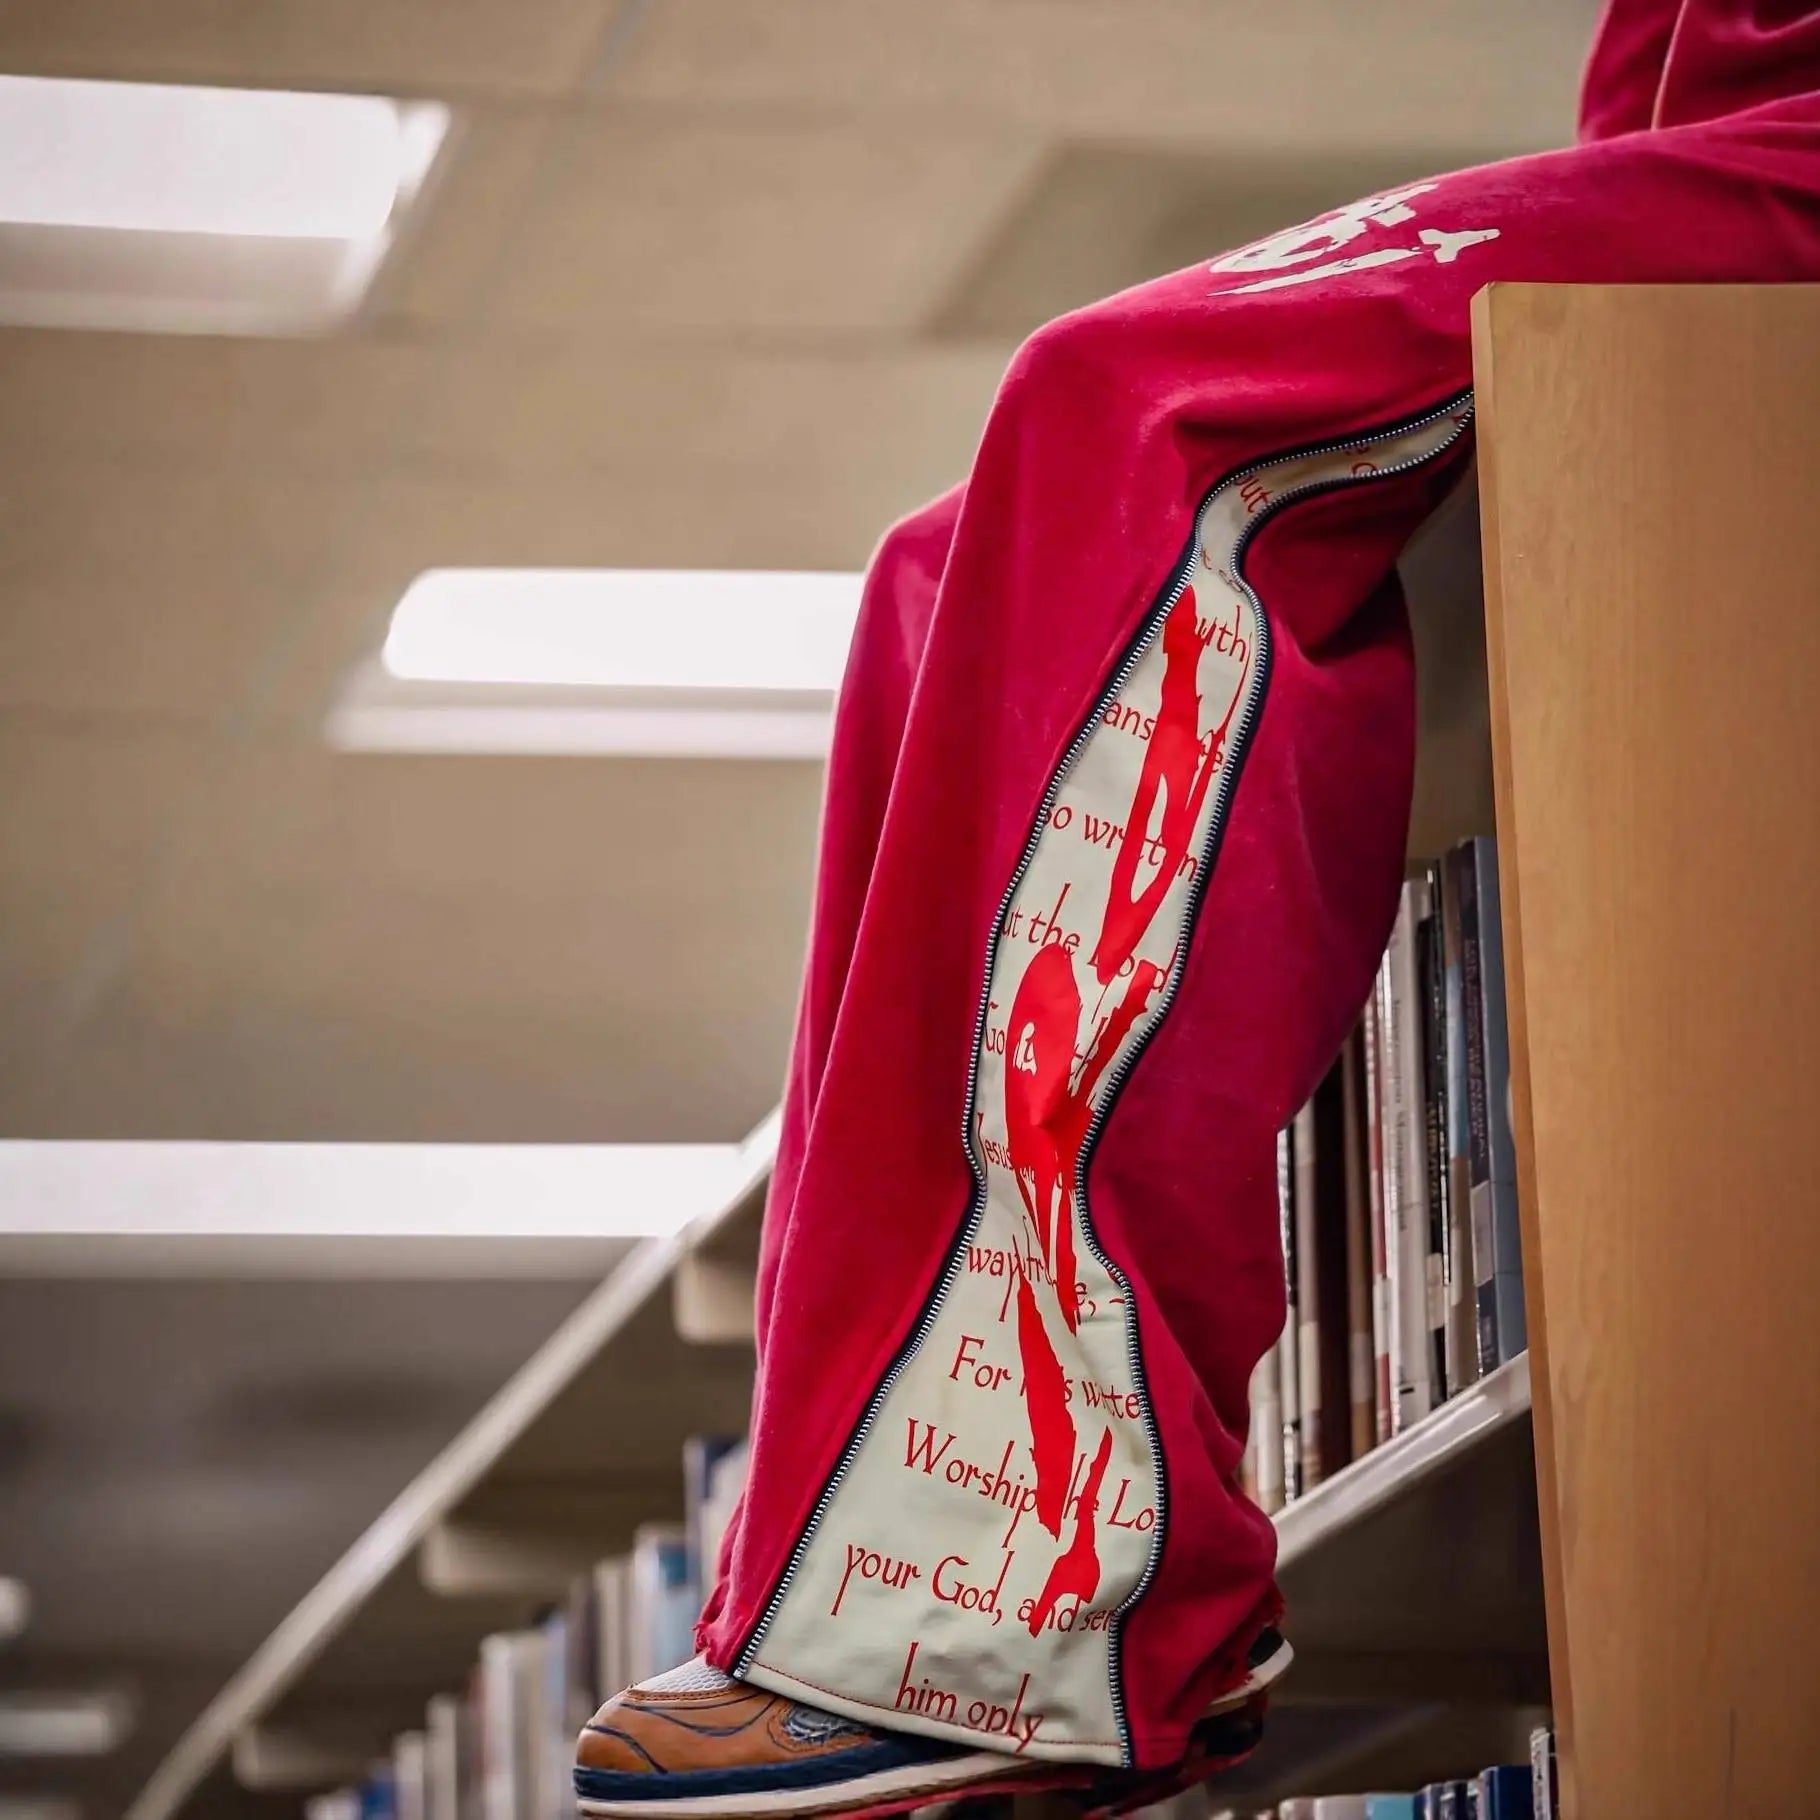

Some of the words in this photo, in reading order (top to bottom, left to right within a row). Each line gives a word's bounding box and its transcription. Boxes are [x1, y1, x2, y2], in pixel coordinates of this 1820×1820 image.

[1195, 604, 1246, 662] uth
[1001, 905, 1023, 938] ut
[1028, 883, 1081, 956] the
[949, 1334, 1013, 1391] For
[903, 1416, 1037, 1549] Worship
[1106, 1478, 1155, 1534] Lo
[830, 1544, 922, 1617] your
[931, 1550, 1015, 1626] God,
[1079, 1608, 1117, 1632] ser
[894, 1641, 957, 1721] him
